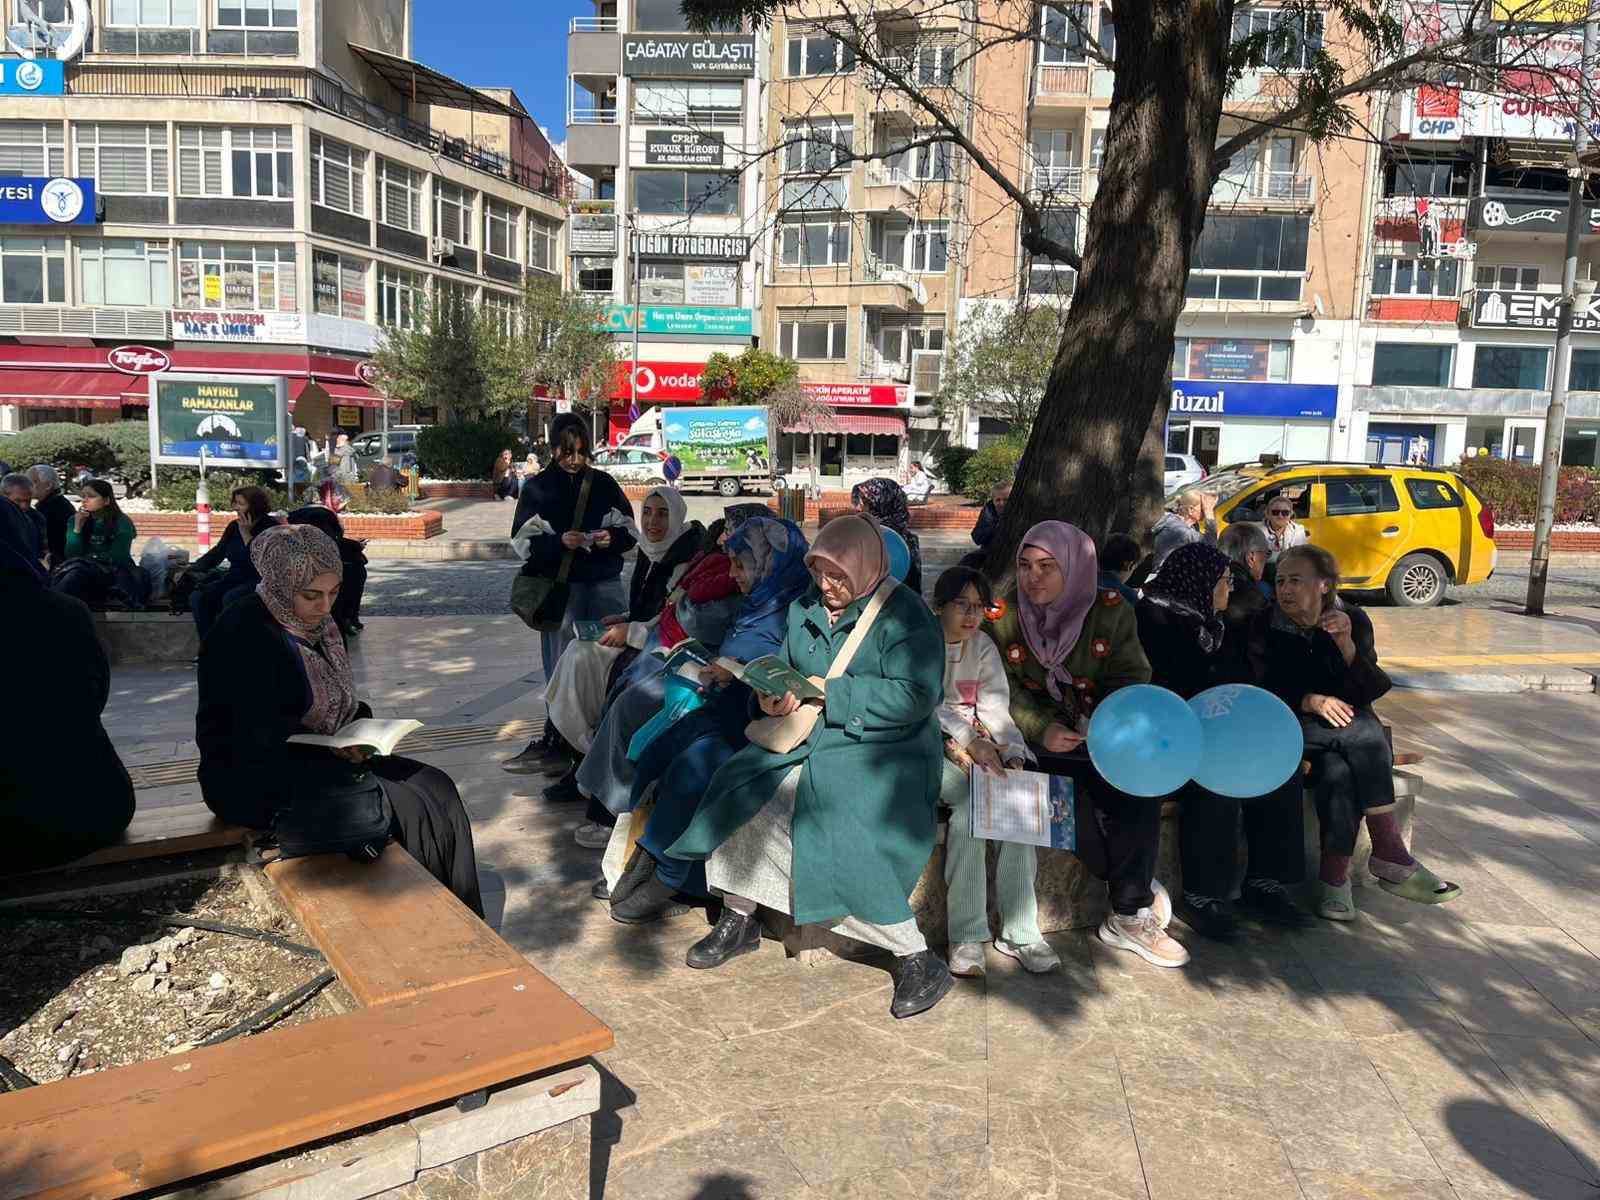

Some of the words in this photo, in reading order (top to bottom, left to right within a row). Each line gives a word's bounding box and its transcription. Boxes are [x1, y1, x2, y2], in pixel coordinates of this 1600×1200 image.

[626, 40, 689, 60] ÇAĞATAY
[692, 40, 753, 61] GÜLAŞTI
[1419, 120, 1455, 134] CHP
[1510, 294, 1600, 320] EMK
[1533, 317, 1599, 328] GRUP
[197, 386, 239, 397] HAYIRLI
[181, 397, 254, 411] RAMAZANLAR
[1170, 389, 1225, 413] fuzul
